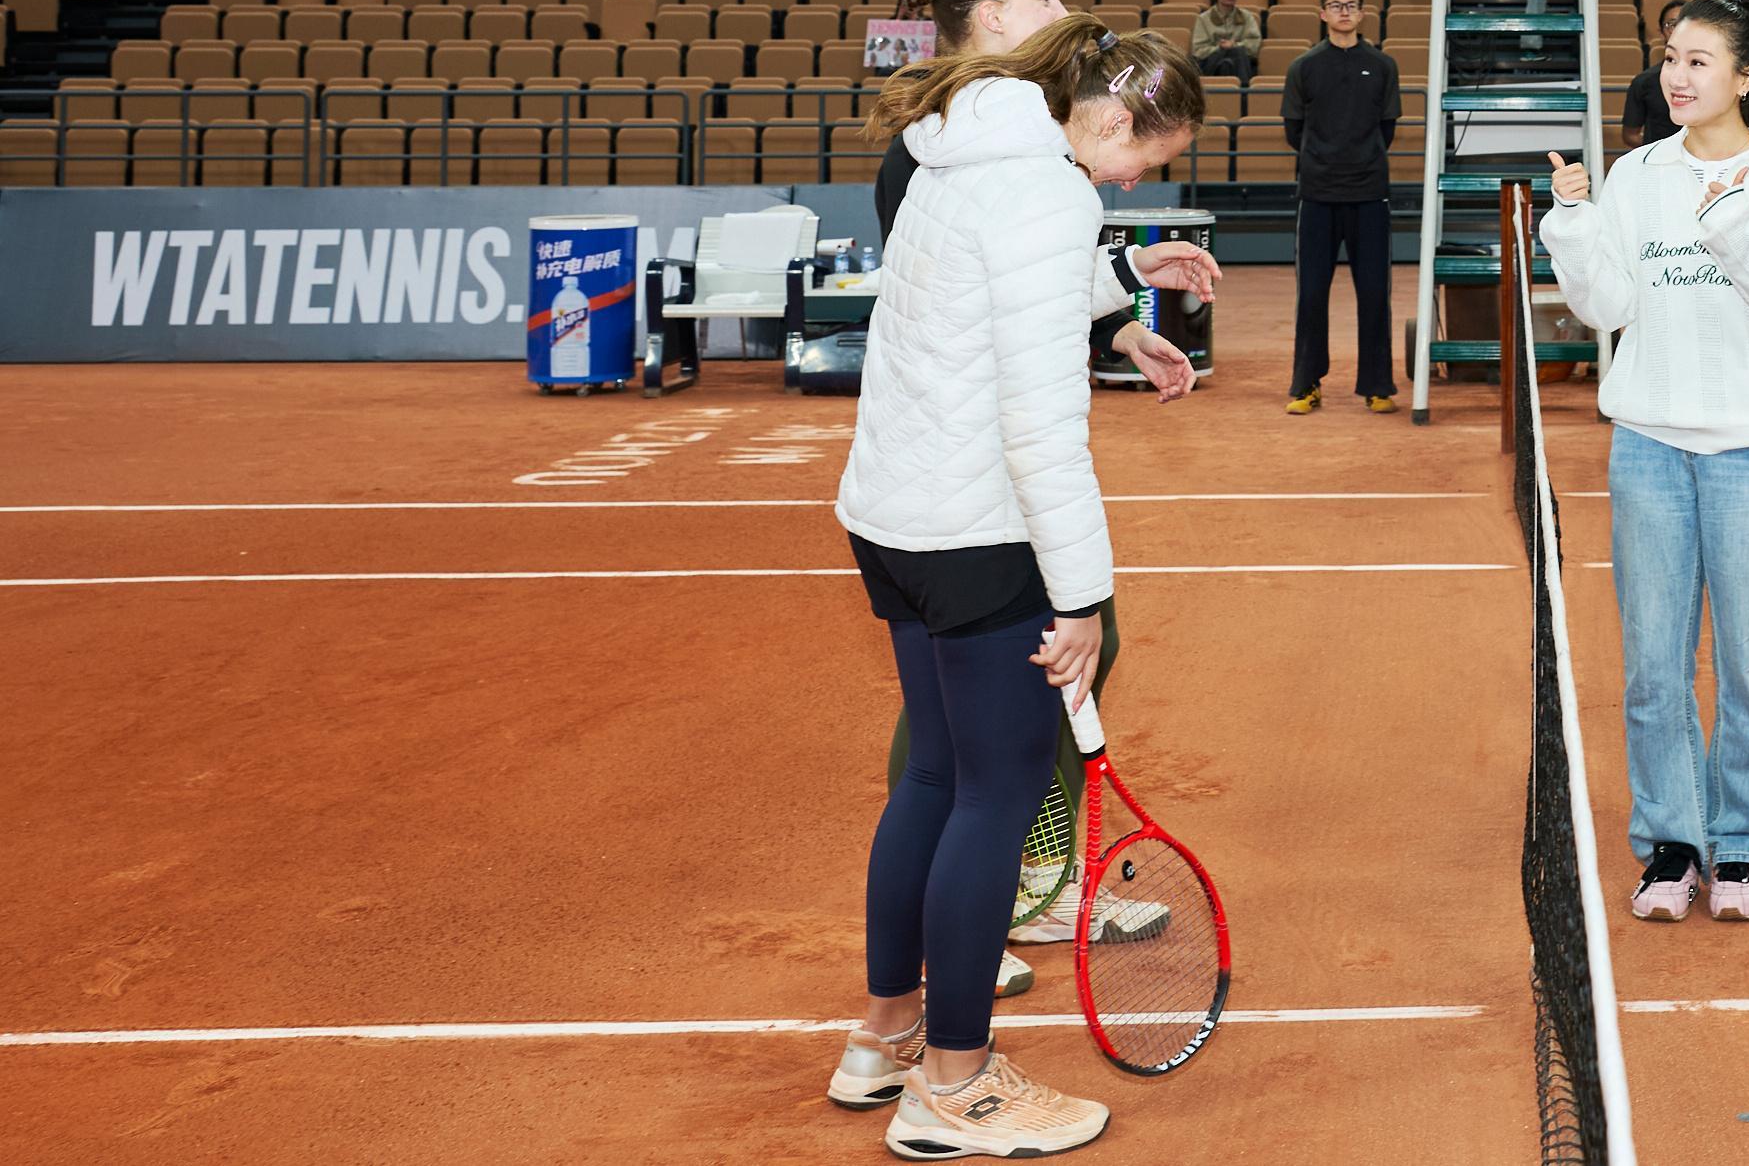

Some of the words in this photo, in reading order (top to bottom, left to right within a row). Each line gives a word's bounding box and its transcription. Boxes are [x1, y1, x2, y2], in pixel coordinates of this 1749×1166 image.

[536, 249, 622, 280] 补充电解质
[537, 240, 573, 260] 快速
[1137, 288, 1155, 331] YONE
